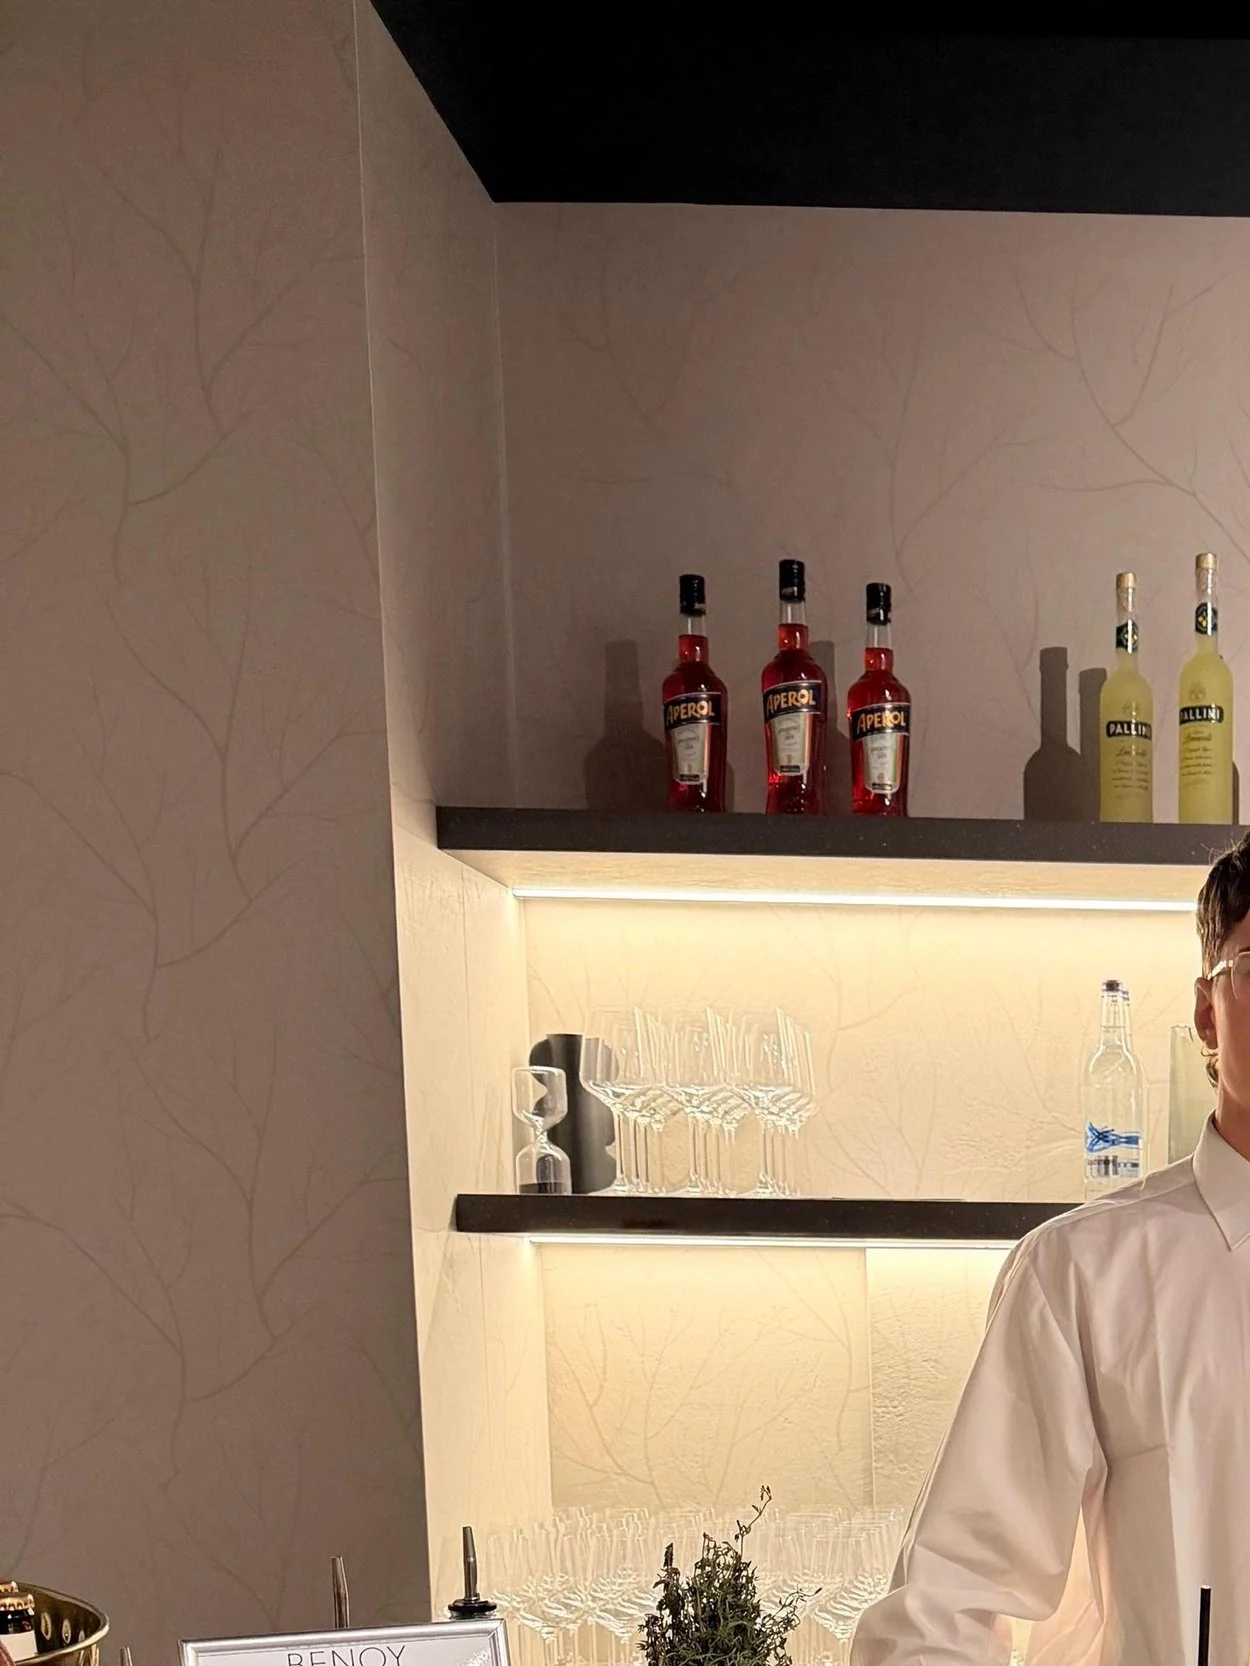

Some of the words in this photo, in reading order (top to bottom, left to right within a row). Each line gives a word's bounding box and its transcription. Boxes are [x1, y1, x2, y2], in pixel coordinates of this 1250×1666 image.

[666, 700, 715, 726] APEROL
[767, 689, 816, 718] APEROL
[856, 710, 906, 735] APEROL
